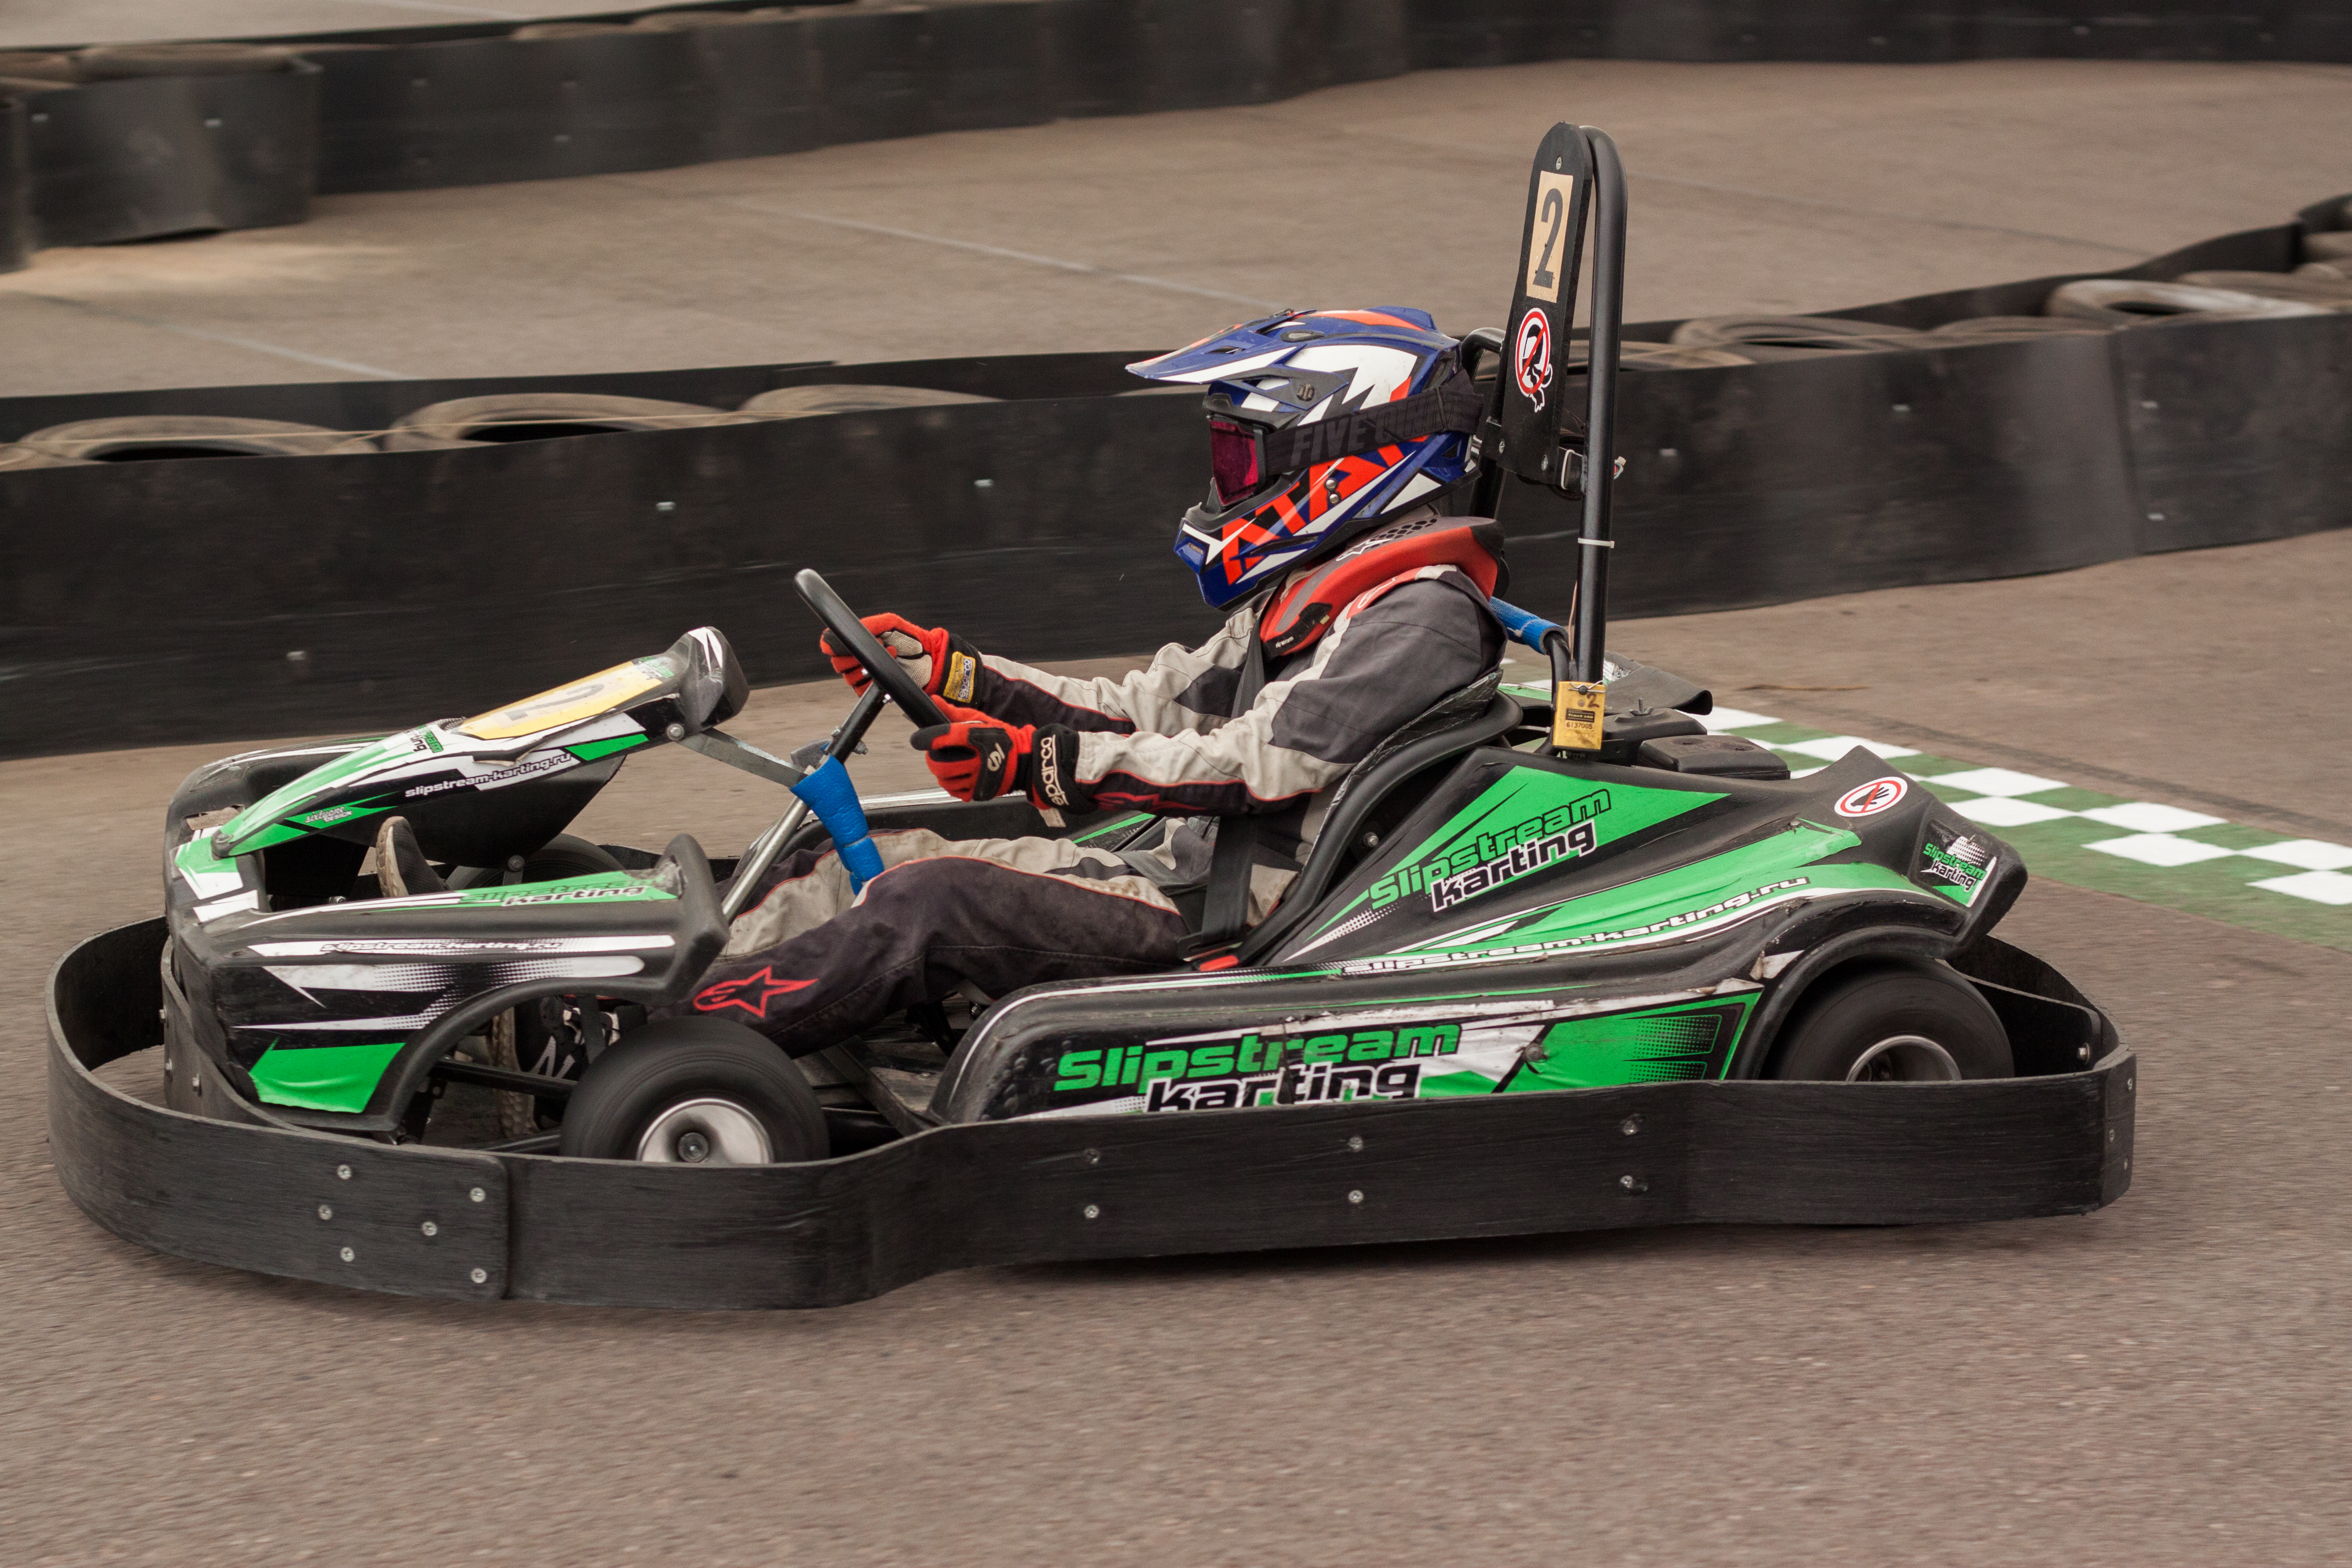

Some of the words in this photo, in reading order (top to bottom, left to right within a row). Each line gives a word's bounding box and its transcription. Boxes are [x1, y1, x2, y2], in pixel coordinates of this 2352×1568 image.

[1533, 188, 1564, 290] 2
[1290, 413, 1369, 467] FIVE
[1587, 693, 1599, 708] 2
[1040, 735, 1069, 806] sparco
[1430, 819, 1597, 912] karting
[1931, 860, 1977, 891] karting
[501, 885, 649, 907] karting
[1143, 1061, 1421, 1113] karting
